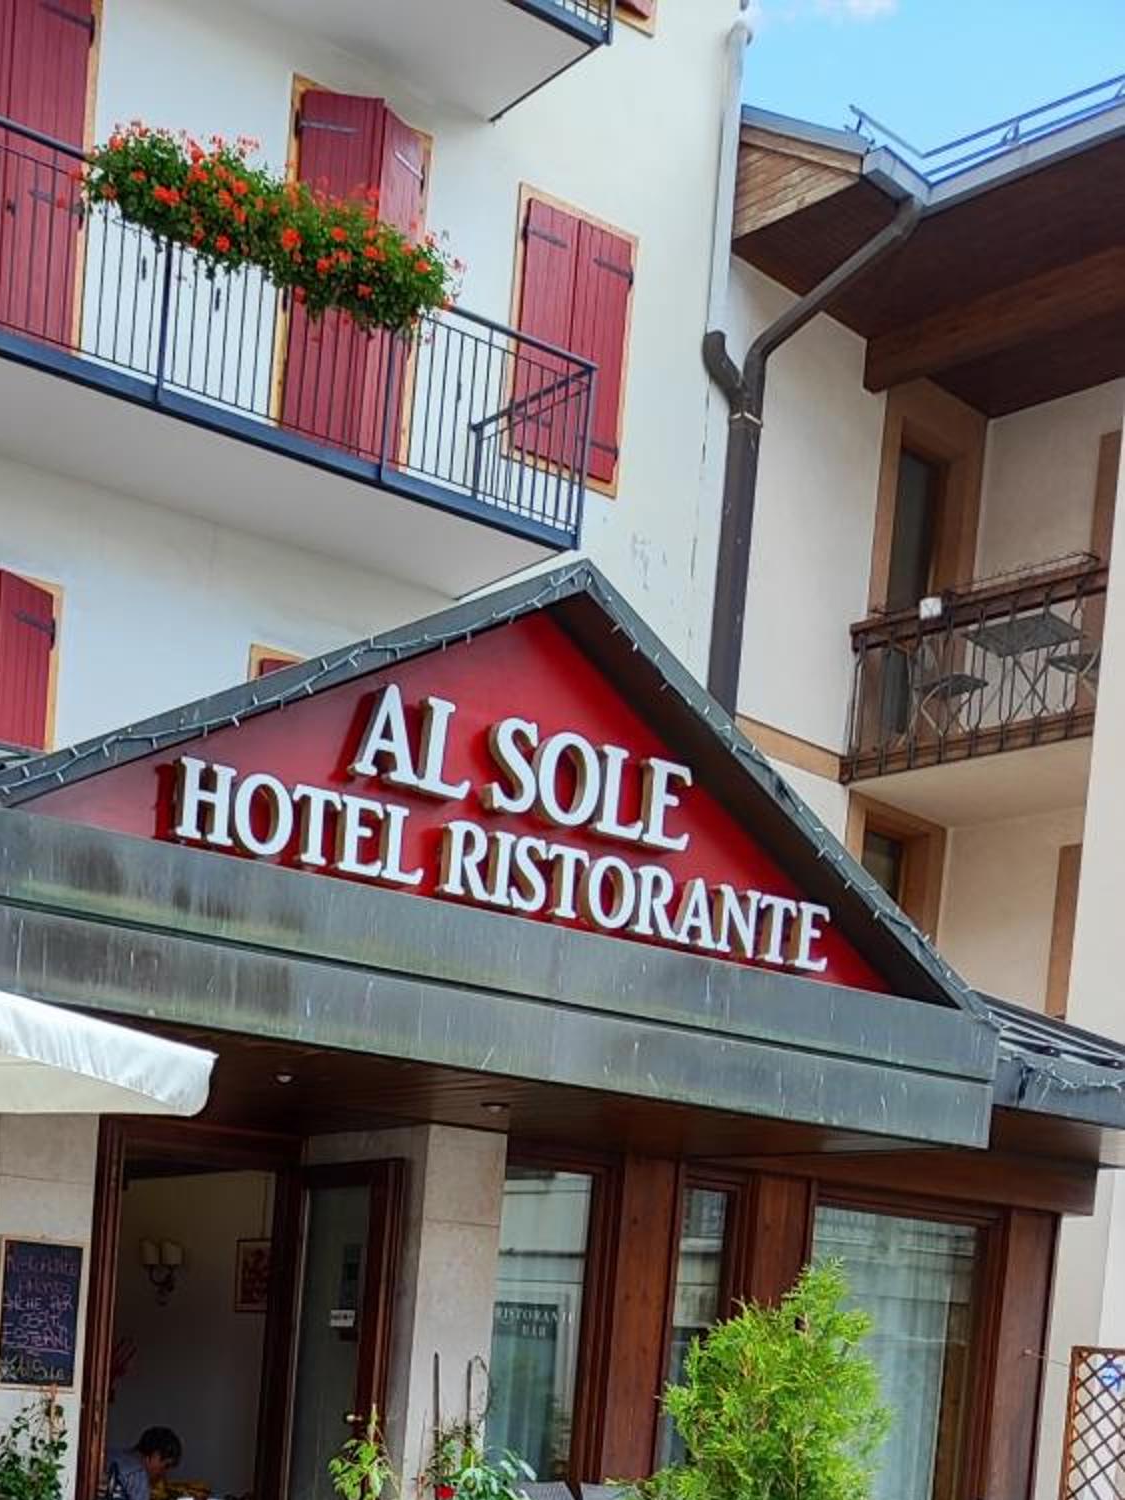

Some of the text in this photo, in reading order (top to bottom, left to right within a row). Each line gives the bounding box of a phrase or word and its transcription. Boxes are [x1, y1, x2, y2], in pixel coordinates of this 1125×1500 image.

[175, 755, 832, 973] HOTEL RISTORANTE
[350, 683, 694, 852] AL SOLE
